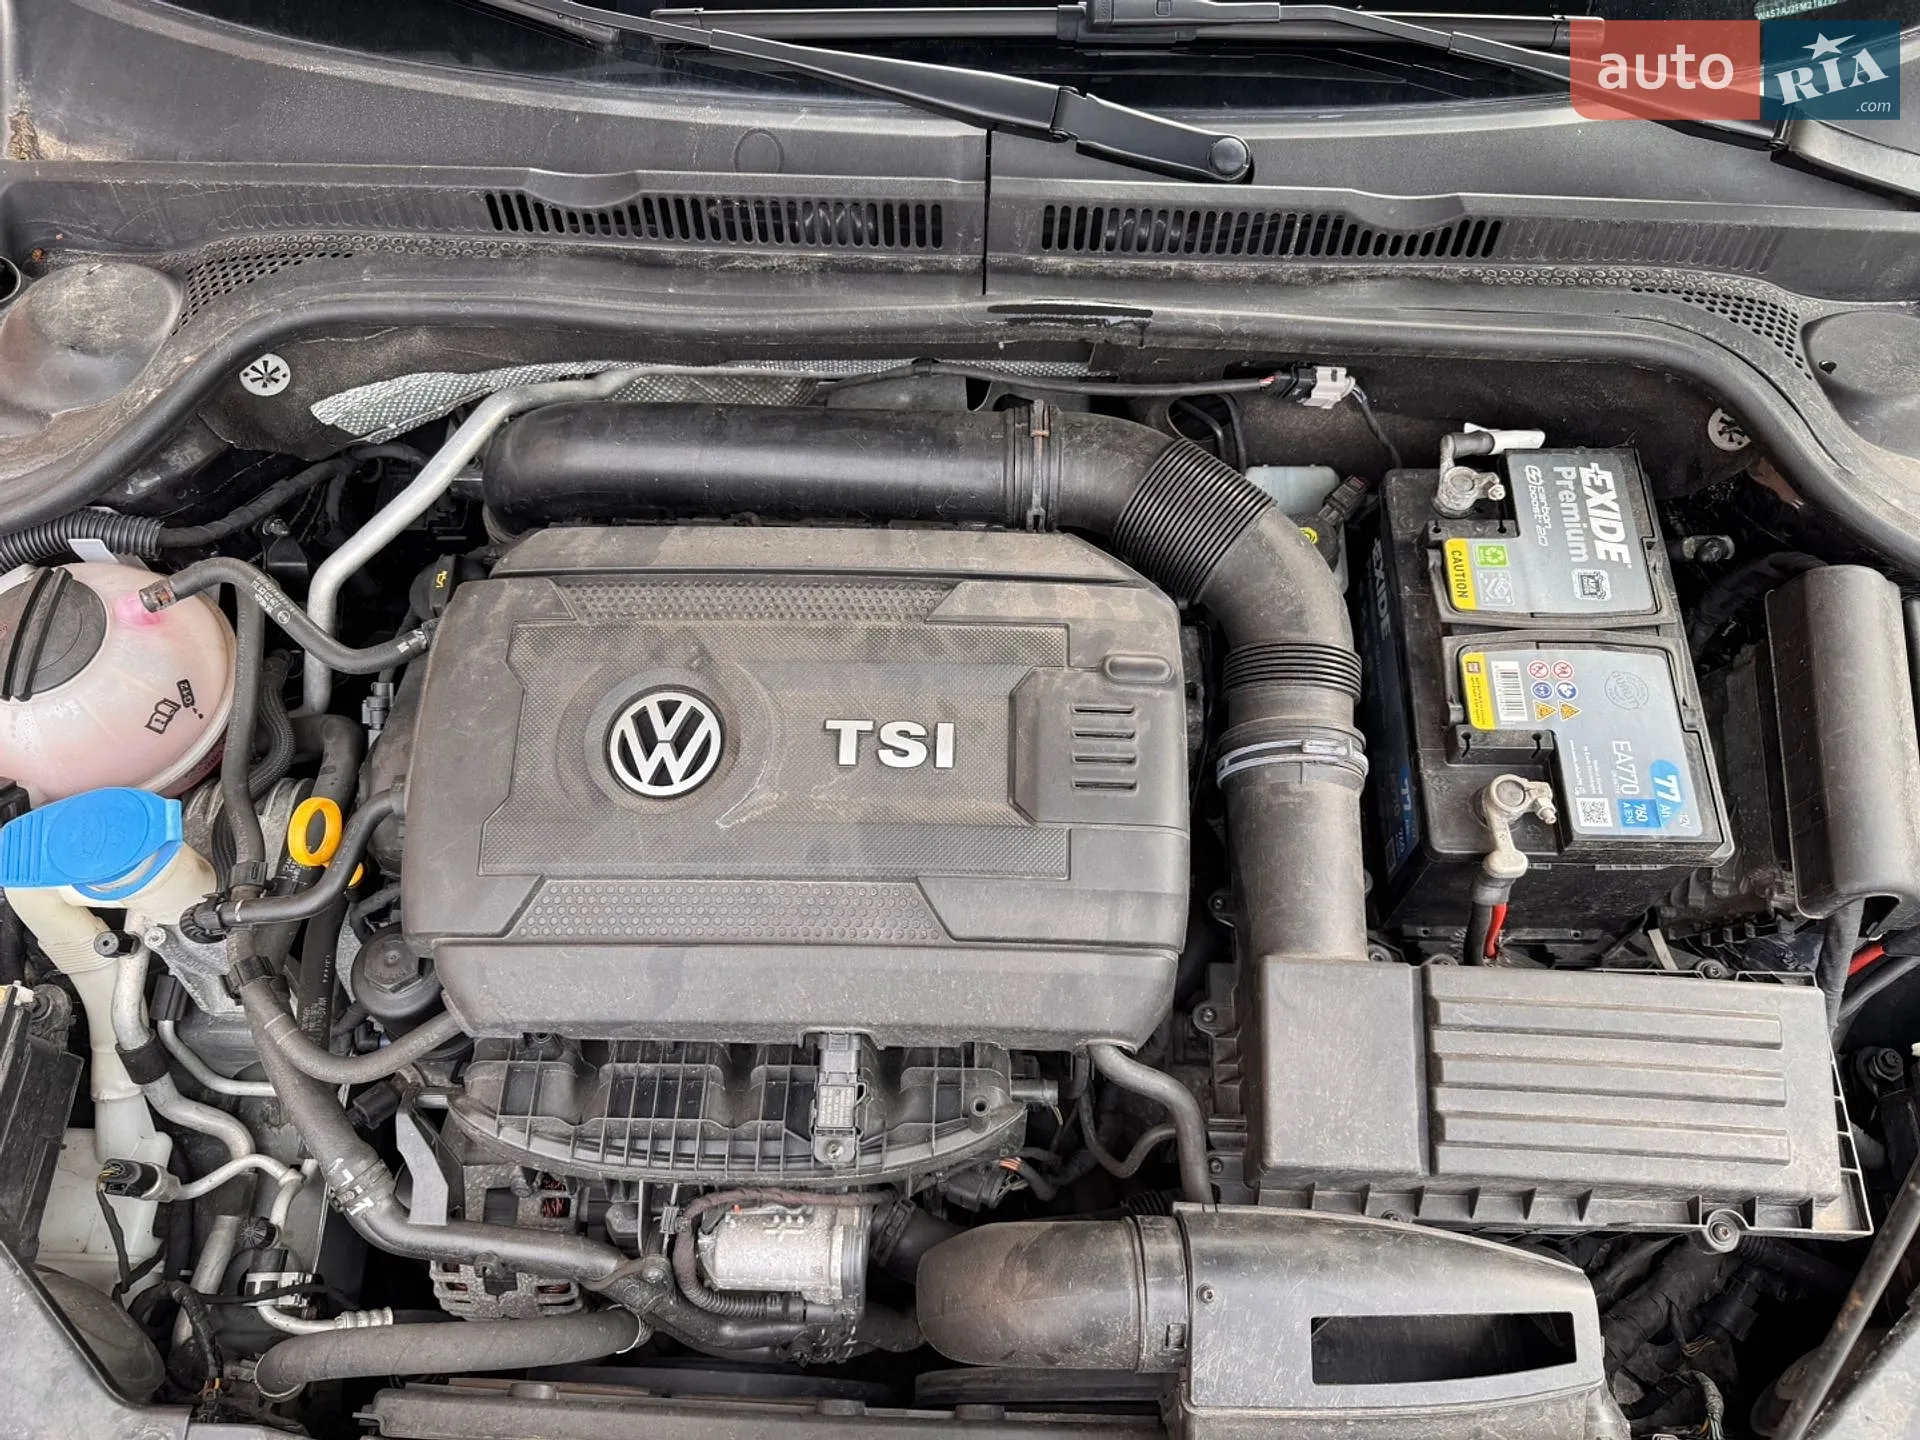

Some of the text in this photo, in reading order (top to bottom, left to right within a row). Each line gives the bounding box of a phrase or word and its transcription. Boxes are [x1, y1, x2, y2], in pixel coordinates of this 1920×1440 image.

[1553, 466, 1588, 562] Premium
[1579, 462, 1632, 565] EXIDE
[1451, 550, 1469, 598] CAUTION
[826, 719, 955, 768] TSI
[1612, 741, 1640, 795] EA770
[1654, 774, 1681, 817] 77 Ah
